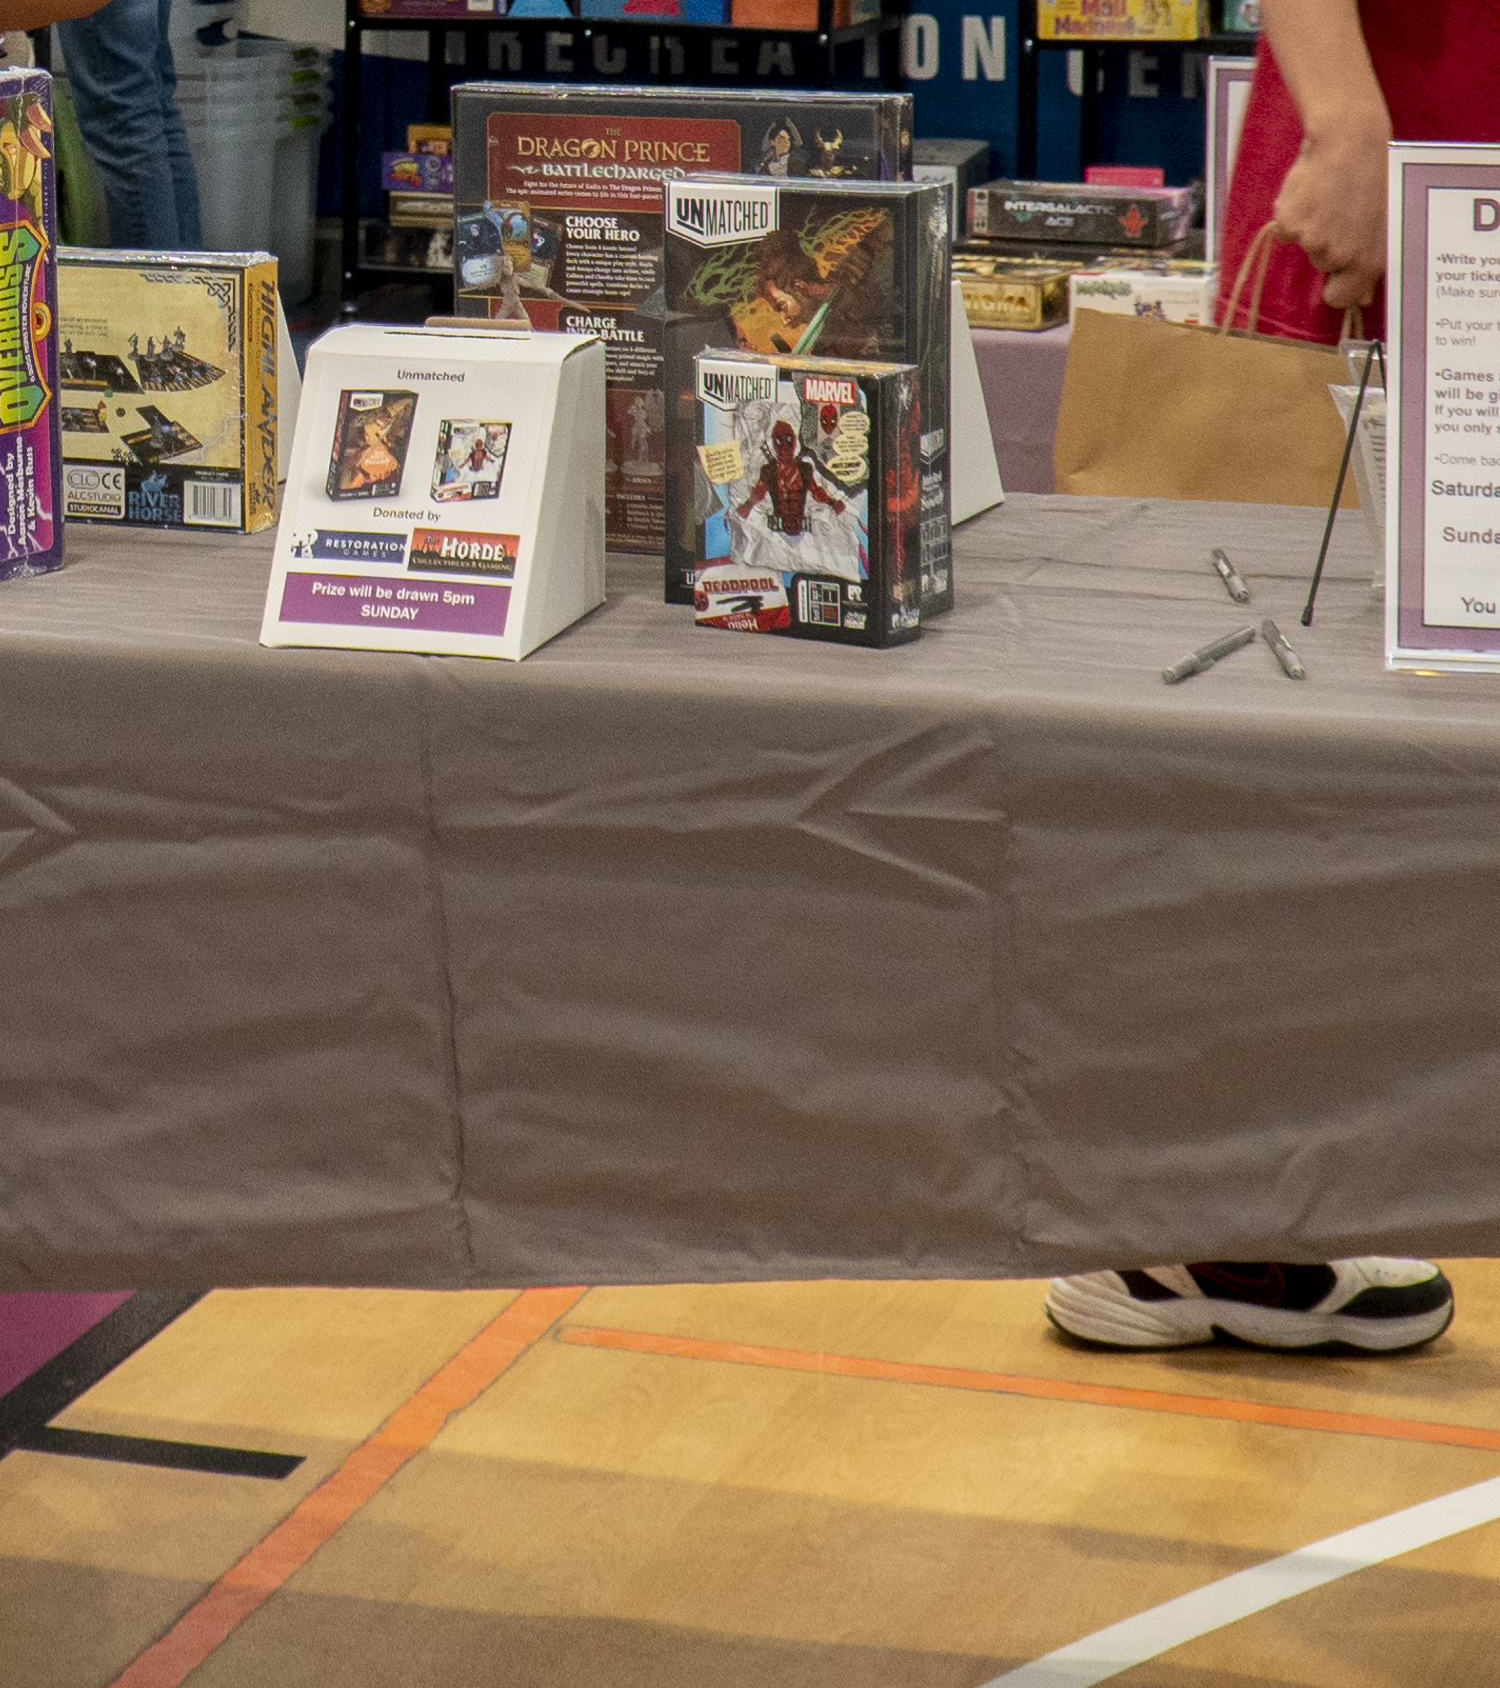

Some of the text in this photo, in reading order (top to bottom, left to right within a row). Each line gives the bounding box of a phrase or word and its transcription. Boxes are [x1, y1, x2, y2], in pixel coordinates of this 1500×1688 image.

[605, 127, 622, 136] THE
[518, 136, 711, 162] DRAGON PRINCE
[566, 216, 618, 229] CHOOSE
[677, 197, 769, 237] UNMATCHED
[566, 228, 641, 242] YOUR HERO
[566, 316, 617, 330] CHARGE
[600, 329, 645, 343] BATTLE
[397, 369, 465, 383] Unmatched
[257, 279, 278, 510] HIGHLANDER
[704, 372, 772, 403] UNMATCHED
[805, 379, 855, 405] MARVEL
[1435, 388, 1460, 399] will
[1466, 388, 1484, 400] be
[5, 453, 14, 471] by
[6, 474, 17, 535] Designed
[128, 492, 181, 508] RIVER
[129, 507, 183, 523] HORSE
[373, 507, 441, 522] Donated by
[325, 537, 504, 562] RESTORATION HORDE
[312, 582, 475, 605] Prize will be drawn 5pm
[704, 578, 779, 594] DEADPOOL
[361, 604, 419, 620] SUNDAY
[1460, 596, 1496, 614] You
